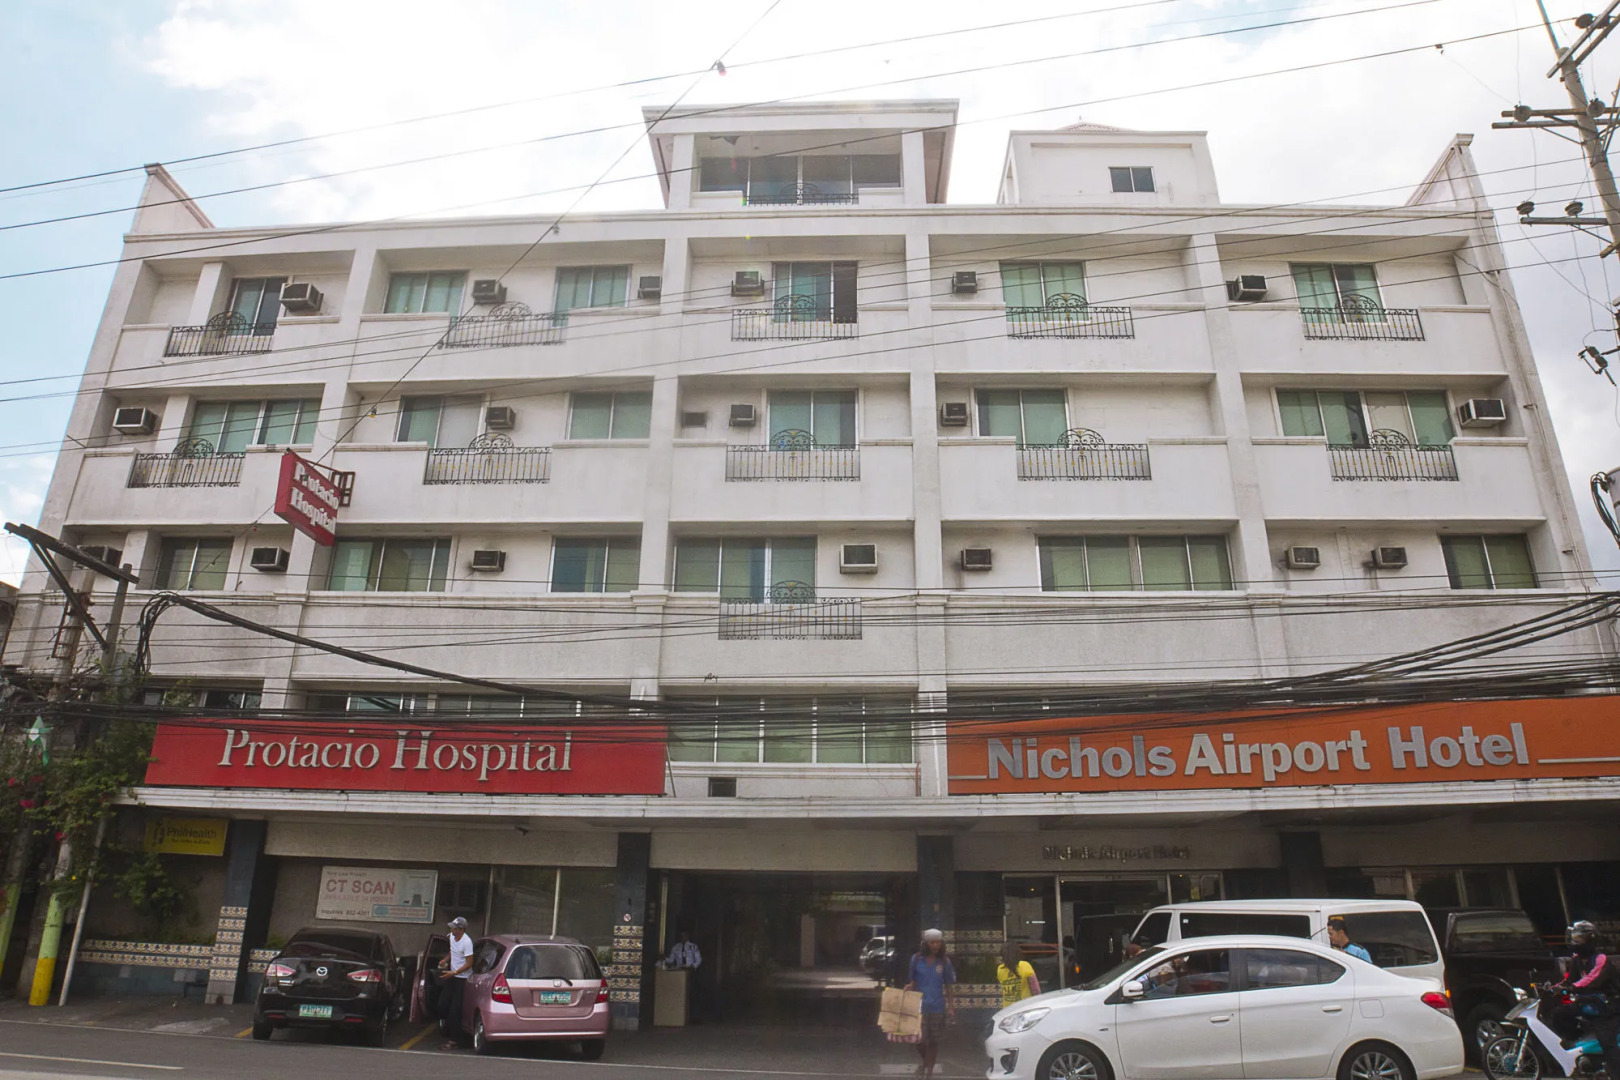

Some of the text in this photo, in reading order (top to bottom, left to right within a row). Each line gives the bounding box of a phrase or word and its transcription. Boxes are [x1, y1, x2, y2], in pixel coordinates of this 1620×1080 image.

[290, 487, 336, 535] Hospital
[217, 728, 573, 782] Protacio Hospital
[987, 722, 1530, 782] Nichols Airport Hotel
[167, 827, 217, 839] PhilHealth
[326, 879, 395, 895] CT SCAN
